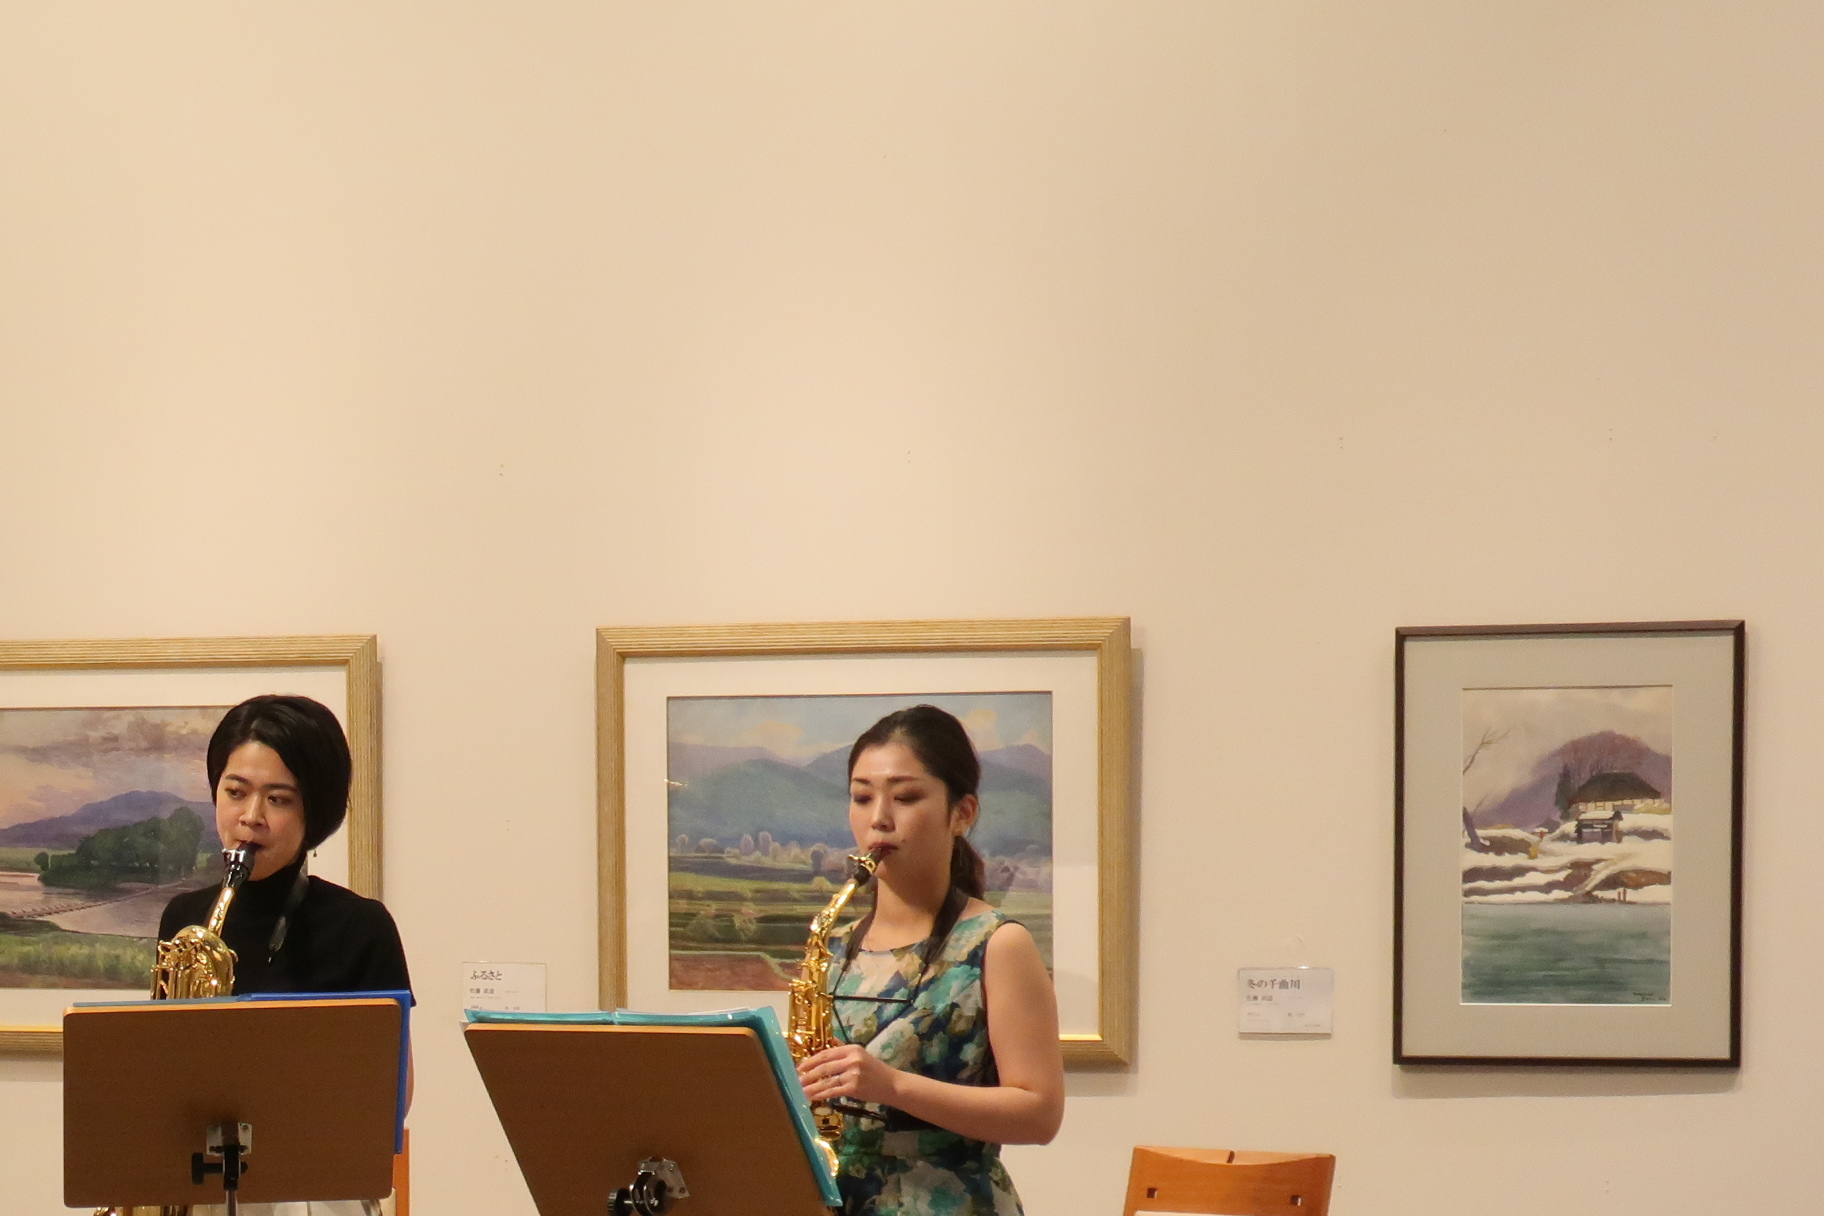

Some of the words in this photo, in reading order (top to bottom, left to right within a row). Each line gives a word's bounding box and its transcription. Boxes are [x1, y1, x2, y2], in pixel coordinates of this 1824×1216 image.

[470, 970, 503, 981] ふるさと
[1247, 979, 1301, 990] 冬の千曲川
